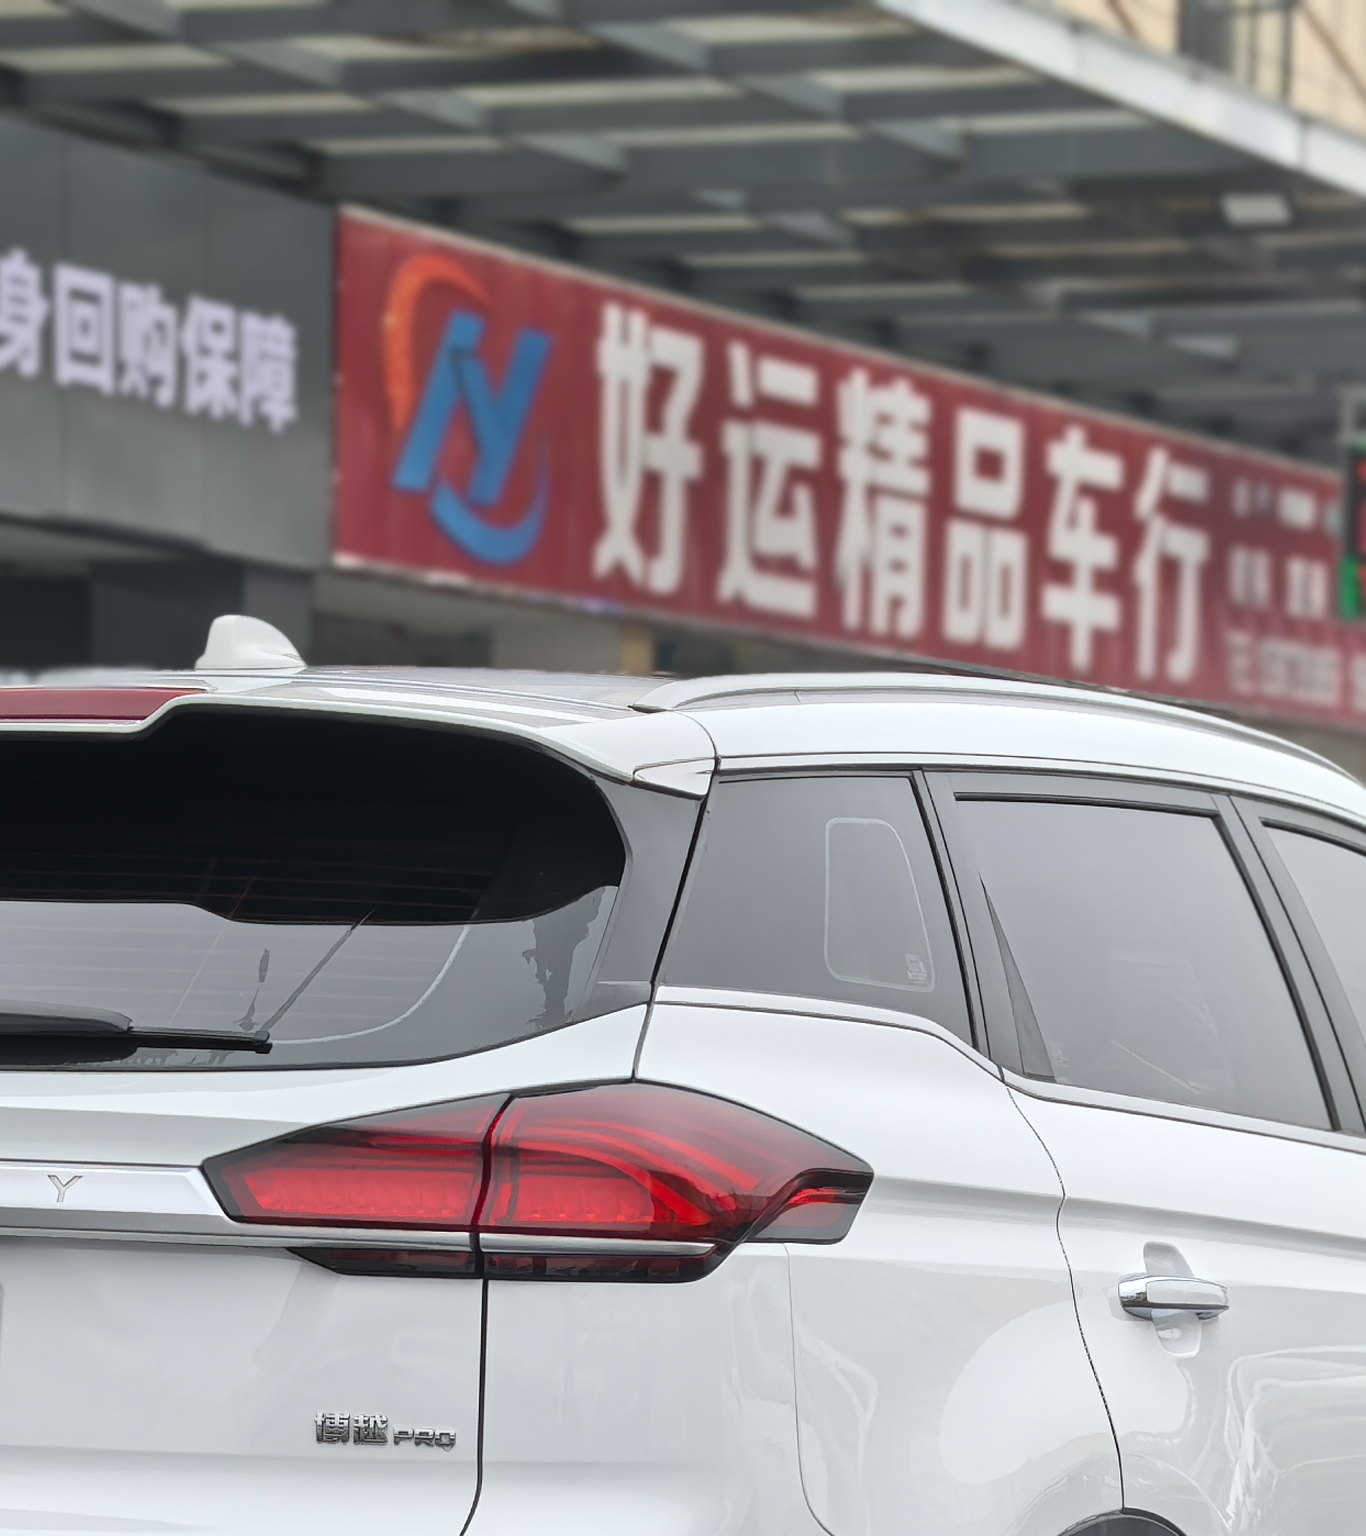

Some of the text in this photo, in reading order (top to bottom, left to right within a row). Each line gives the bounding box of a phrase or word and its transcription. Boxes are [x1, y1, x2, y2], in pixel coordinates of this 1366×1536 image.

[593, 302, 1211, 683] 好运精品车行
[315, 1412, 456, 1452] 博越 PRO
